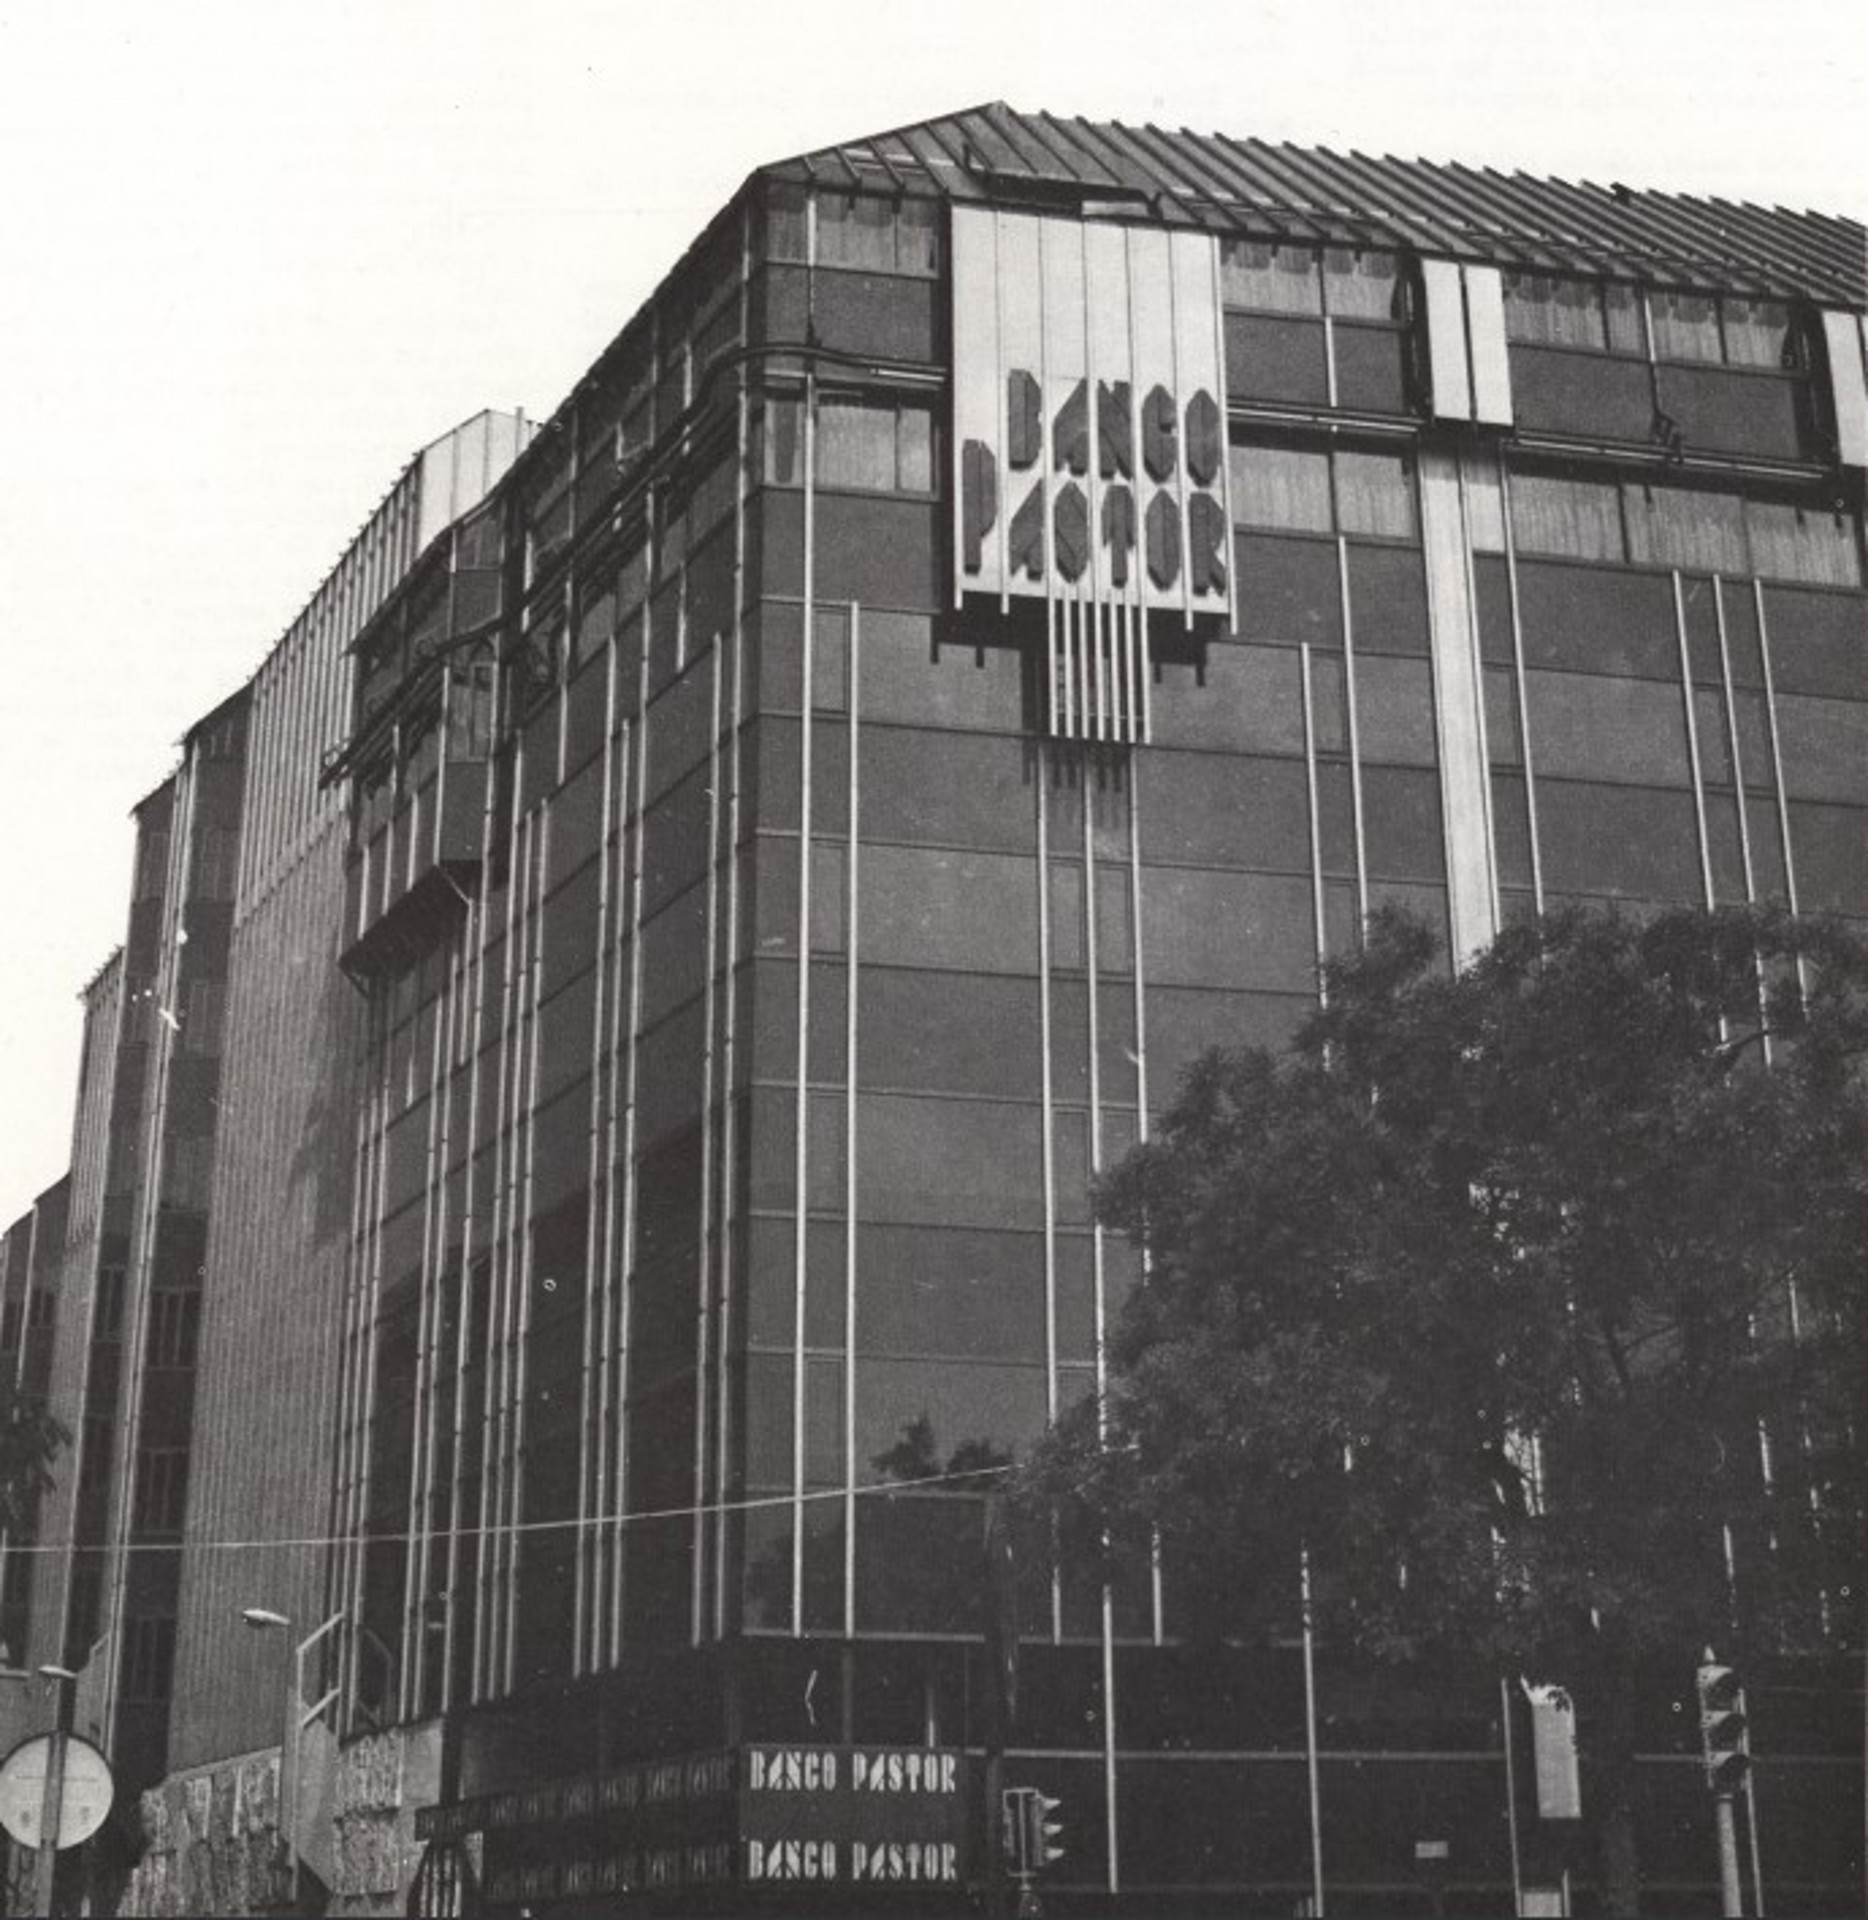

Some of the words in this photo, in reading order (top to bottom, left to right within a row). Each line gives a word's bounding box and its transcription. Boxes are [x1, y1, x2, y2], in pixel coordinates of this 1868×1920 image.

[1008, 368, 1222, 488] BANCO
[962, 438, 1228, 597] PASTOR
[749, 1751, 837, 1791] BANCO
[852, 1752, 957, 1793] PASTOR
[748, 1840, 837, 1880] BANCO
[852, 1842, 957, 1882] PASTOR
